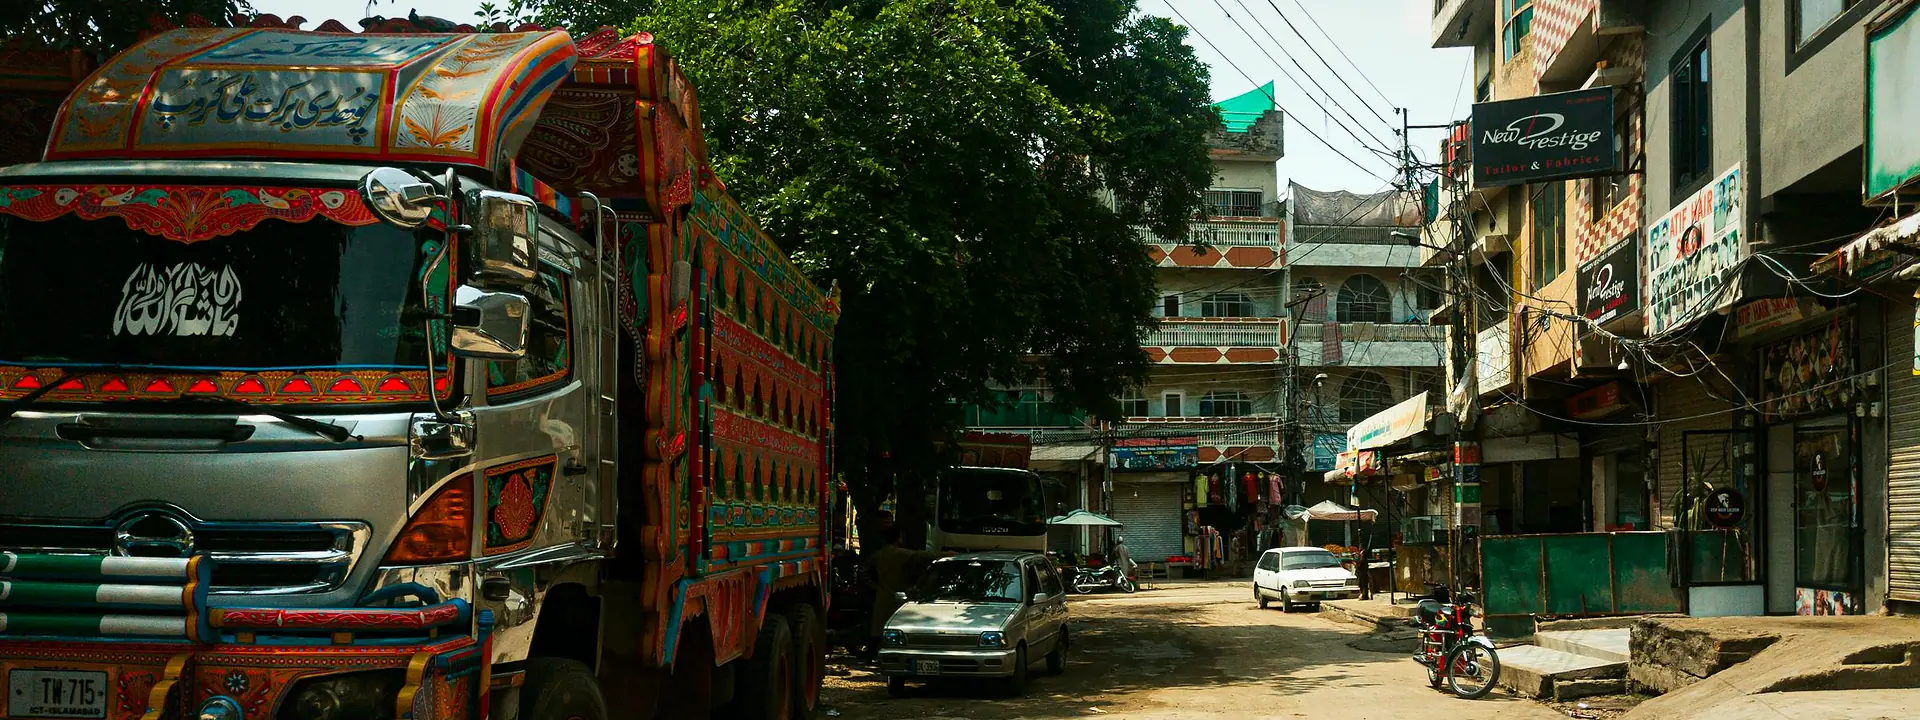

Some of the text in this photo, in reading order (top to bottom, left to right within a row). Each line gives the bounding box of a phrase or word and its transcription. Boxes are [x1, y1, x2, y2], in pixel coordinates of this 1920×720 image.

[1482, 109, 1601, 150] New Prestige
[1531, 161, 1540, 170] &
[1670, 189, 1713, 240] ATIF HAIR
